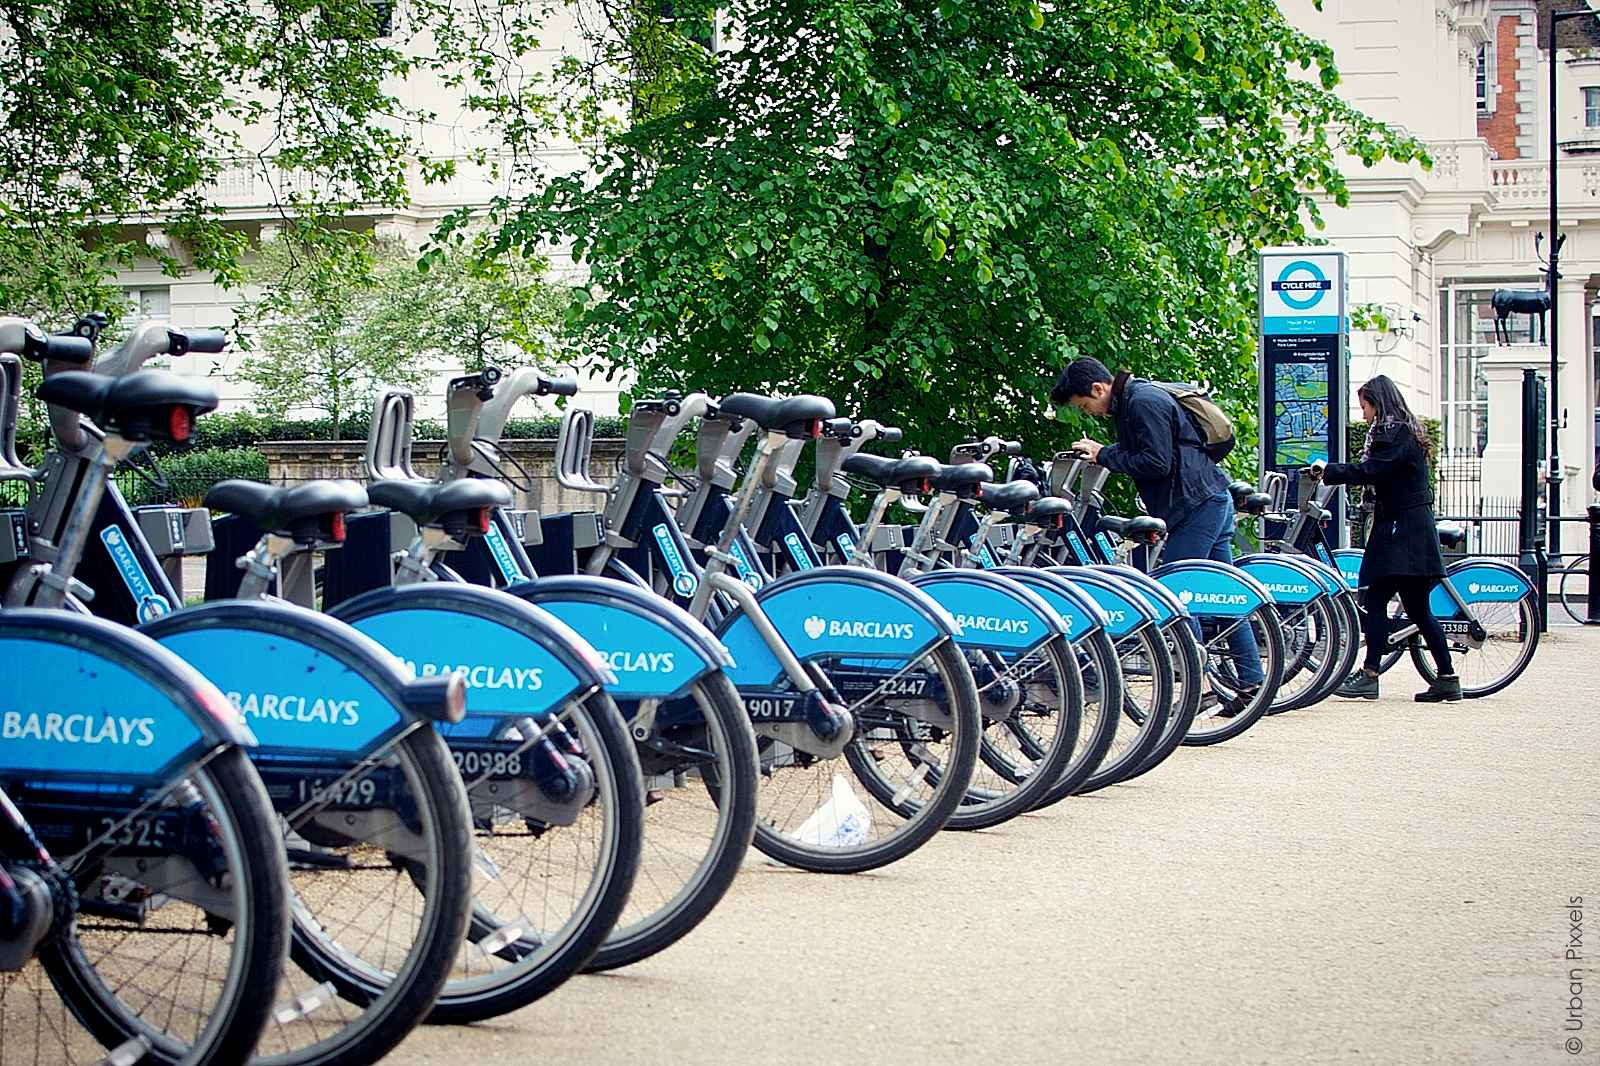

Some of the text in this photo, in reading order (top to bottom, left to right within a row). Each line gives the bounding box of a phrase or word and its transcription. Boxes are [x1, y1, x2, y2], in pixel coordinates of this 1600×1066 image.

[114, 544, 147, 596] BARCLAYS
[1195, 592, 1248, 605] BARCLAYS
[1480, 584, 1519, 593] BARCLAYS
[828, 620, 914, 640] BARCLAYS
[955, 614, 1029, 634] BARCLAYS
[879, 679, 927, 695] 22447
[743, 699, 795, 717] 9017
[2, 711, 155, 747] BARCLAYS
[453, 751, 522, 775] 20988
